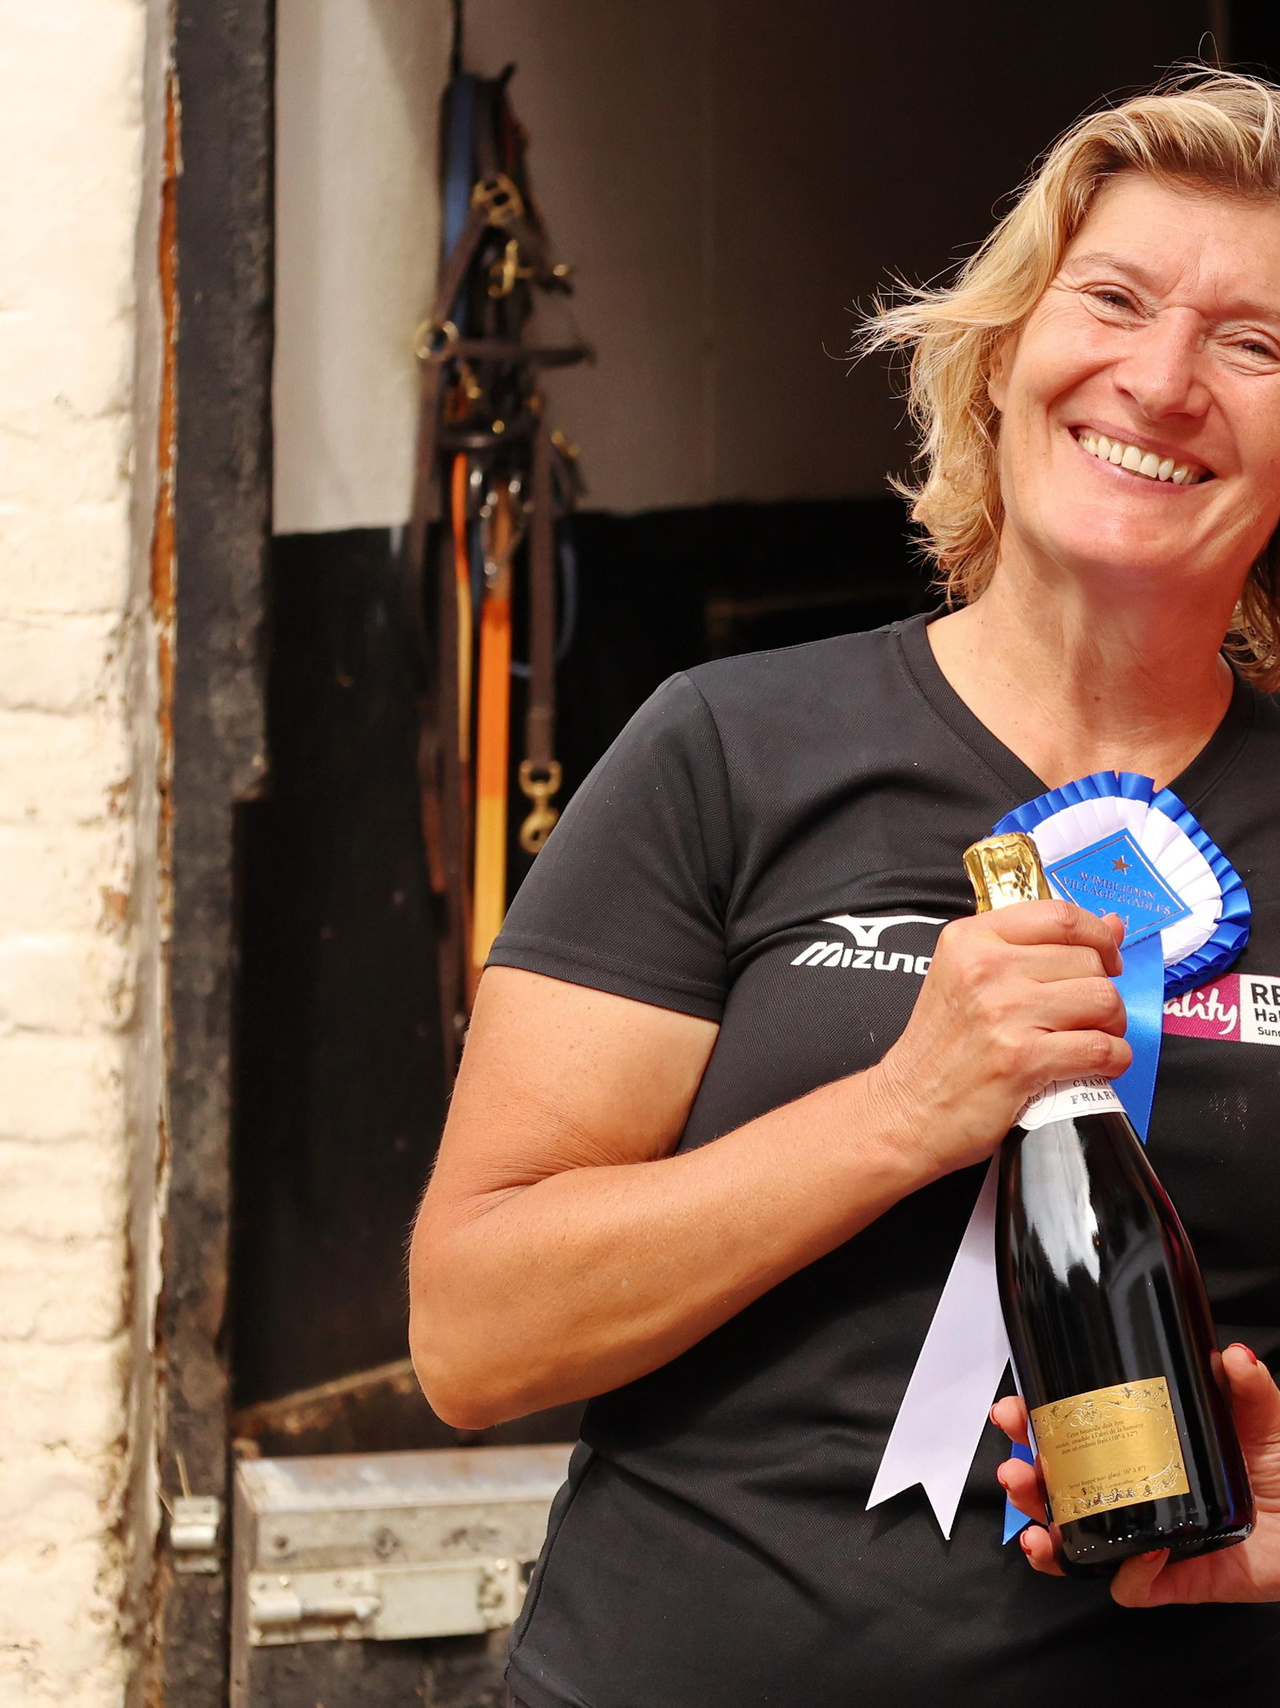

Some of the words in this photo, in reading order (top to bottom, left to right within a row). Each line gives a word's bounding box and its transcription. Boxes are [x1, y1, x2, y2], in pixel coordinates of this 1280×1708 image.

[1062, 876, 1115, 901] VILLAGE
[1117, 894, 1171, 915] STABLES
[1079, 871, 1156, 901] WIMBLEDON
